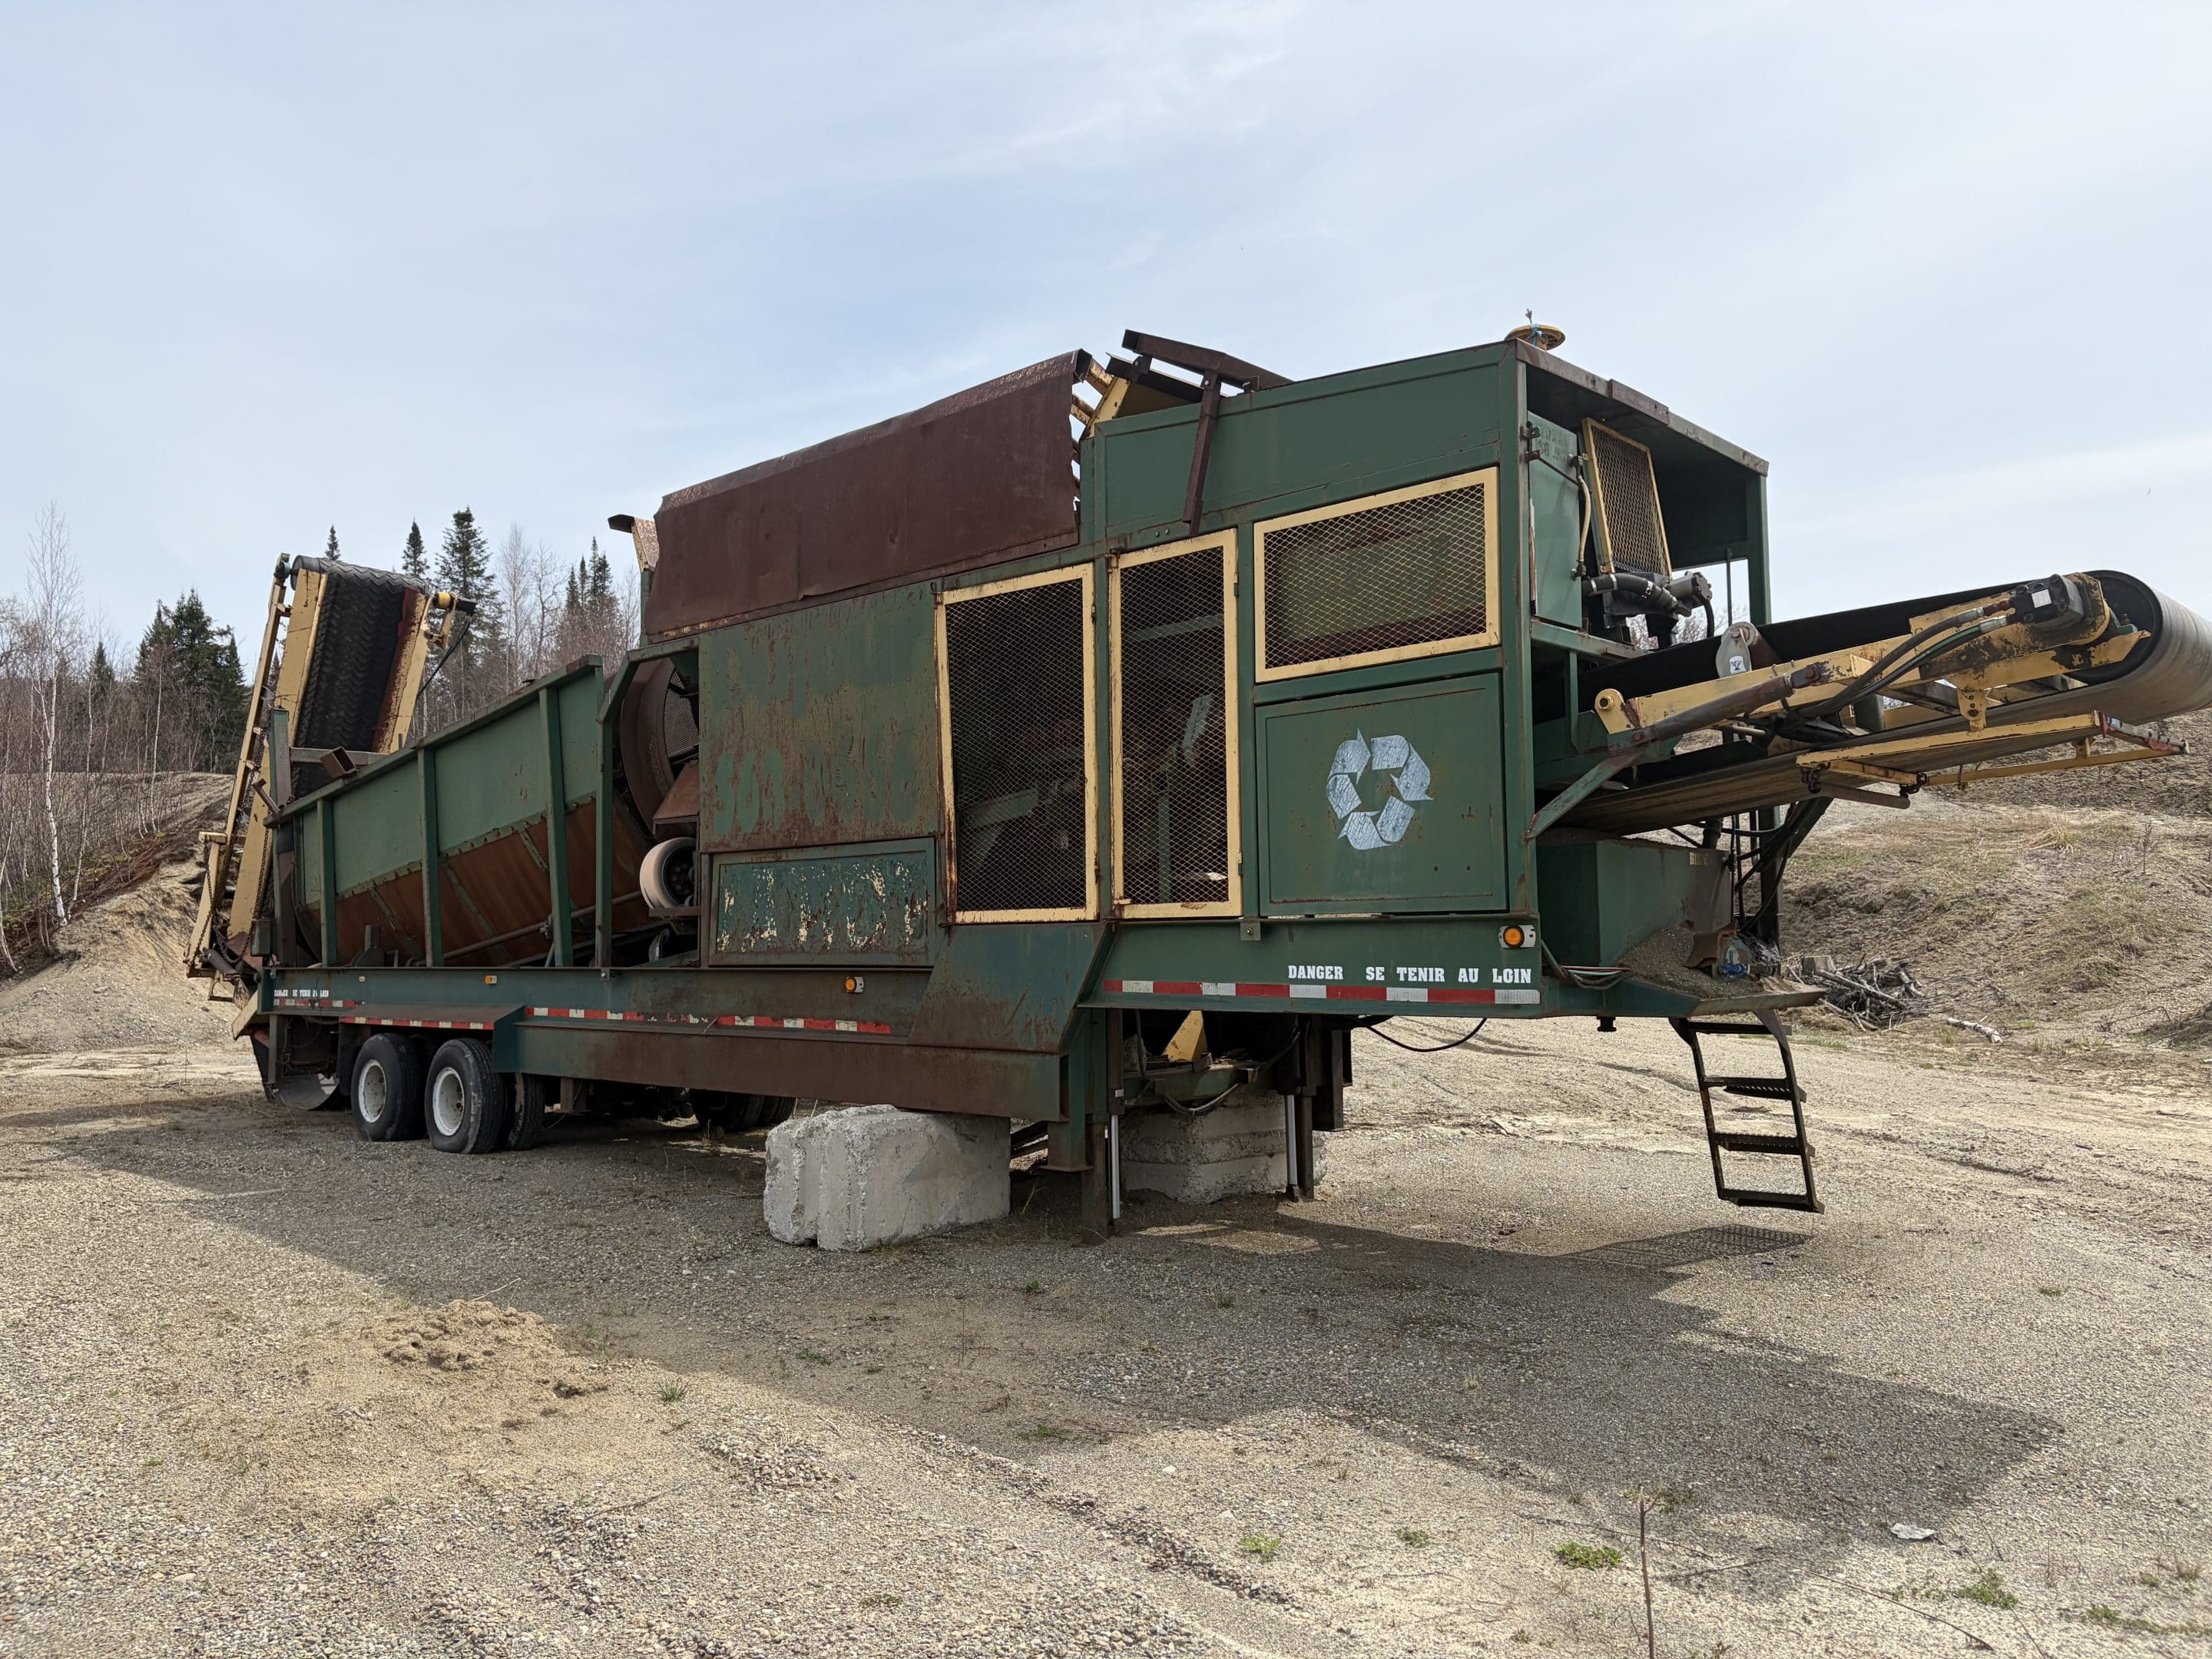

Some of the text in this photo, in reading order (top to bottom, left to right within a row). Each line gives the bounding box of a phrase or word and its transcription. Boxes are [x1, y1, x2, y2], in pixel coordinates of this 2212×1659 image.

[1288, 965, 1532, 984] DANGER SE TENIR AU LOIN
